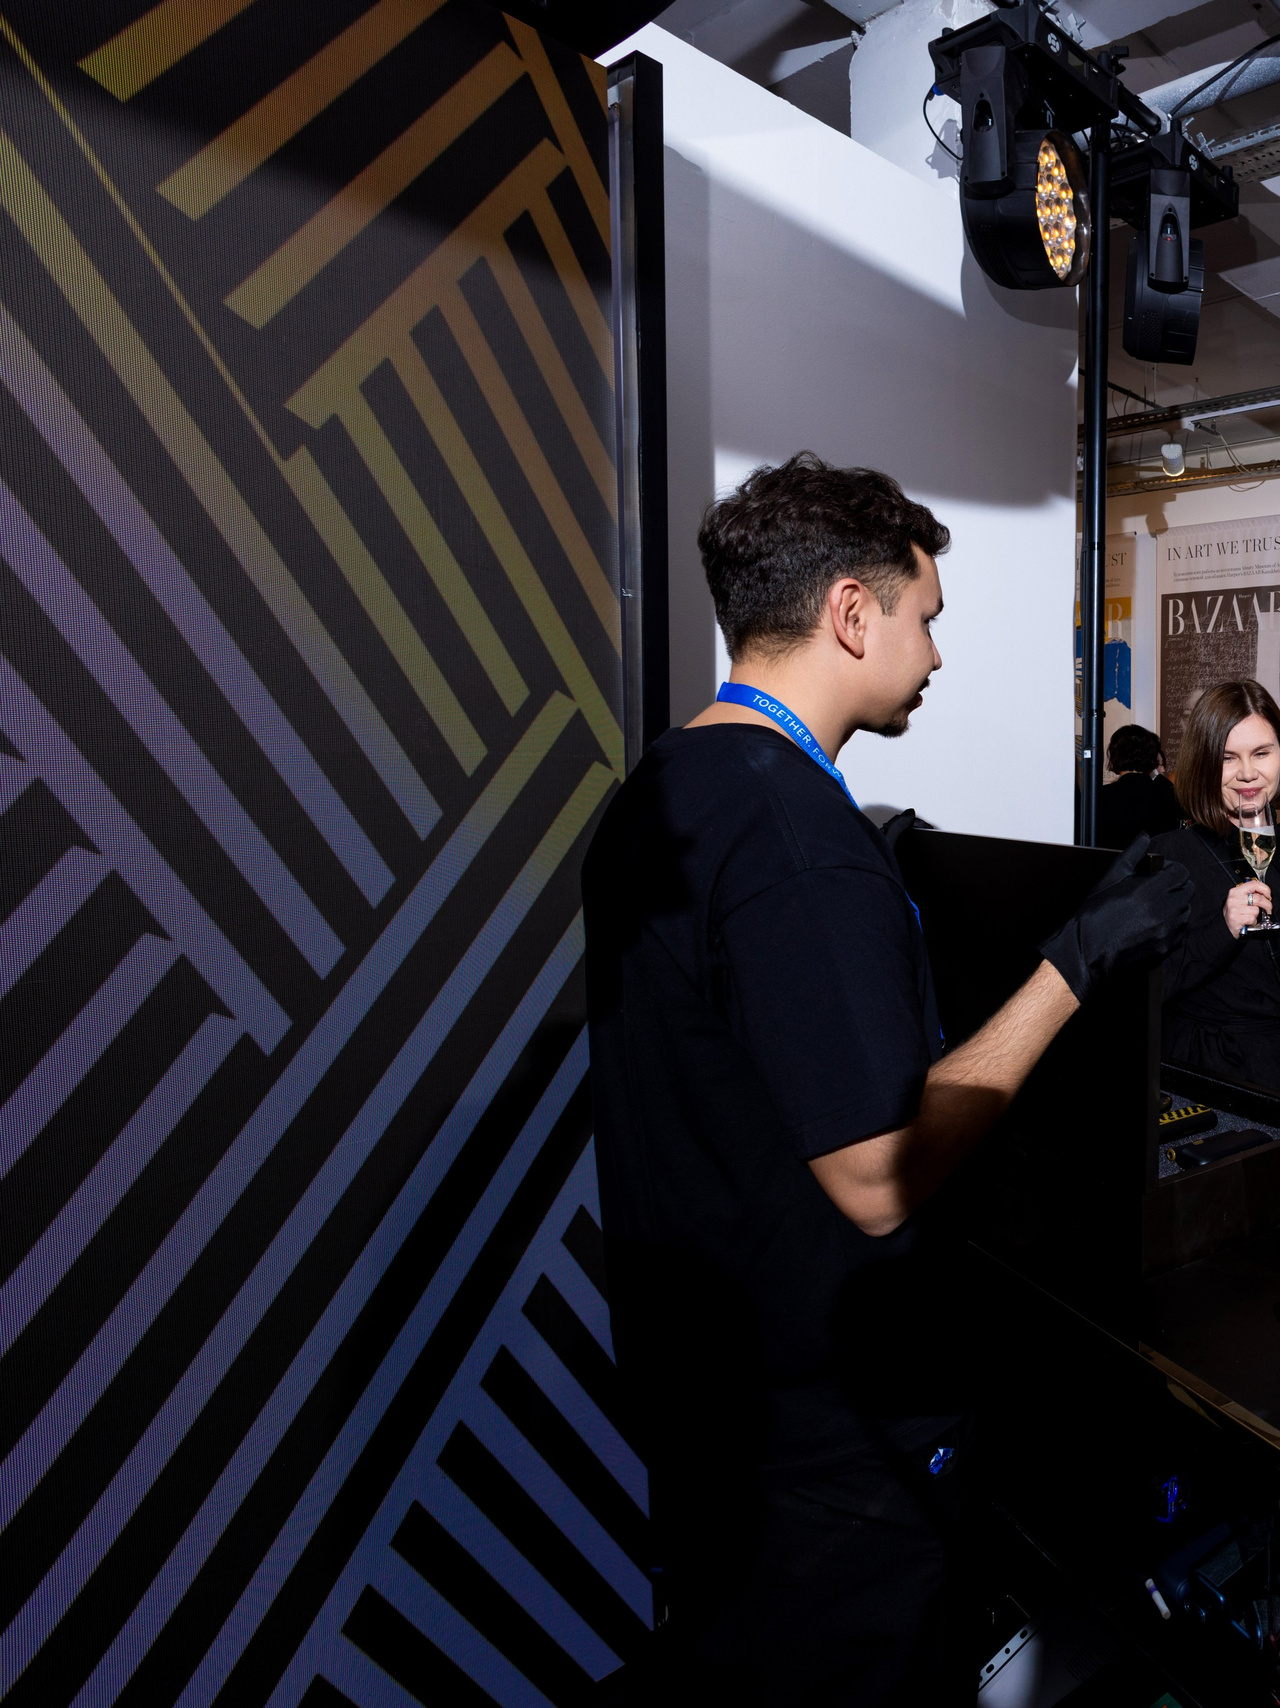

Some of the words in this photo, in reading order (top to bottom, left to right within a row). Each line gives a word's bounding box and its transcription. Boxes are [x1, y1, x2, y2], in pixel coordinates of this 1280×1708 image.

[1167, 546, 1181, 560] IN
[1185, 543, 1212, 559] ART
[1216, 540, 1239, 555] WE
[752, 694, 812, 748] TOGETHER.
